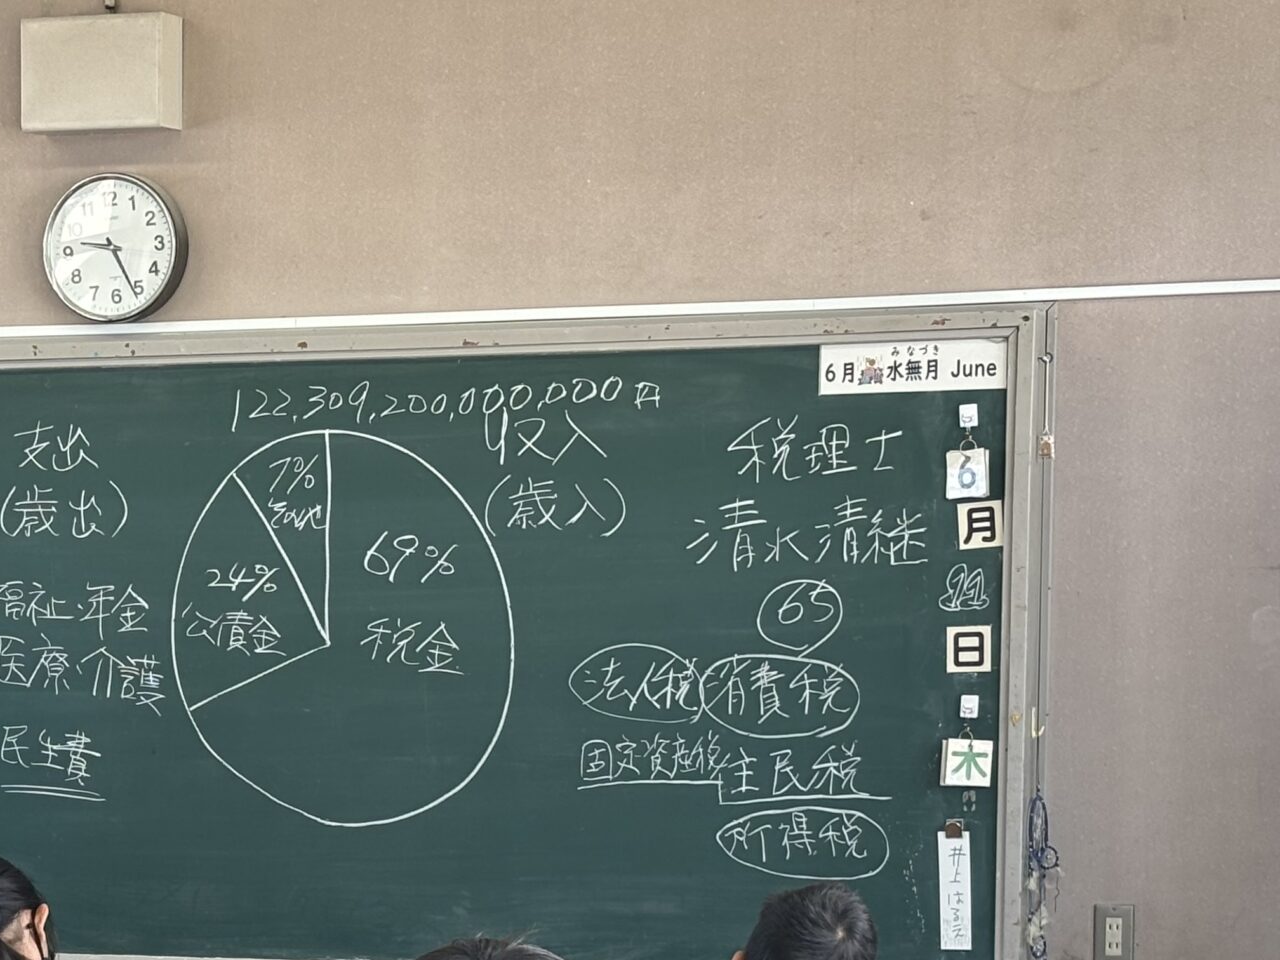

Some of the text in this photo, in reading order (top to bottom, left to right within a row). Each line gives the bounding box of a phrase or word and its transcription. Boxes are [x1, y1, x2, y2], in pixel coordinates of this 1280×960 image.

[128, 194, 137, 211] 1
[145, 210, 157, 227] 2
[154, 235, 165, 251] 3
[71, 269, 82, 284] 8
[148, 260, 161, 276] 4
[89, 285, 100, 301] 7
[111, 288, 122, 304] 6
[133, 280, 144, 296] 5
[891, 344, 940, 357] みなづき
[825, 358, 998, 383] 6月 水無月 June
[14, 420, 100, 472] 支出
[484, 407, 608, 465] 収入
[727, 414, 903, 483] 税理士
[268, 454, 319, 495] 7%
[957, 452, 977, 490] 6
[962, 506, 996, 545] 月
[363, 531, 459, 584] 69%
[206, 562, 280, 602] 24%
[778, 579, 834, 624] 65
[360, 618, 464, 675] 税金
[953, 632, 985, 667] 日
[0, 725, 102, 787] 民生費
[951, 745, 987, 781] 木
[724, 811, 869, 863] 所得税
